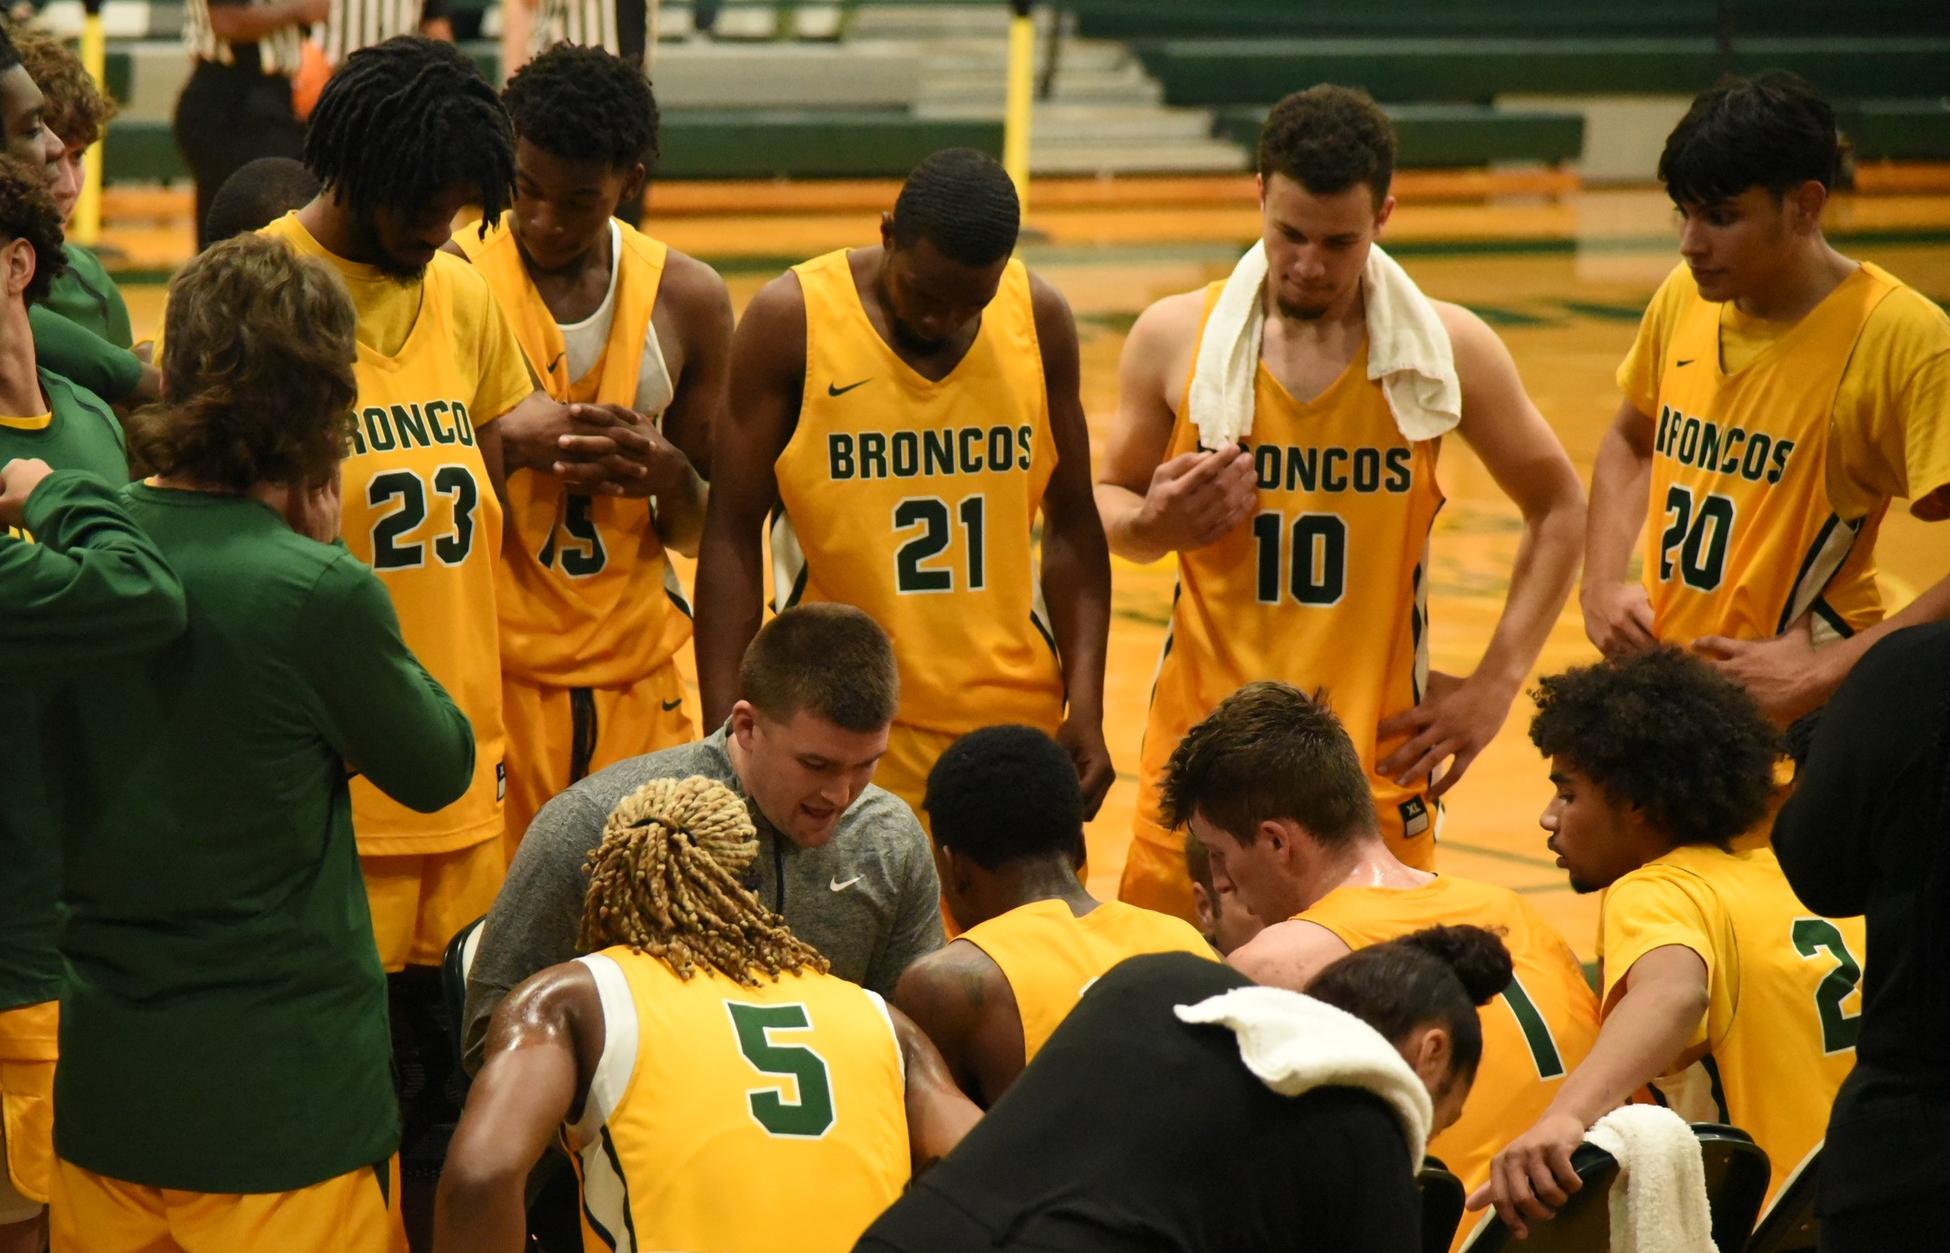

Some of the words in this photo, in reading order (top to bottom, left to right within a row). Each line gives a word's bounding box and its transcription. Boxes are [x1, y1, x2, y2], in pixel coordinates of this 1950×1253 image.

[349, 400, 474, 456] RONCO
[828, 425, 1032, 480] BRONCOS
[1198, 442, 1412, 494] ONCOS
[366, 463, 480, 573] 23
[892, 493, 985, 595] 21
[1253, 511, 1348, 608] 10
[1660, 483, 1736, 594] 20
[1406, 802, 1422, 816] XL
[722, 998, 838, 1141] 5
